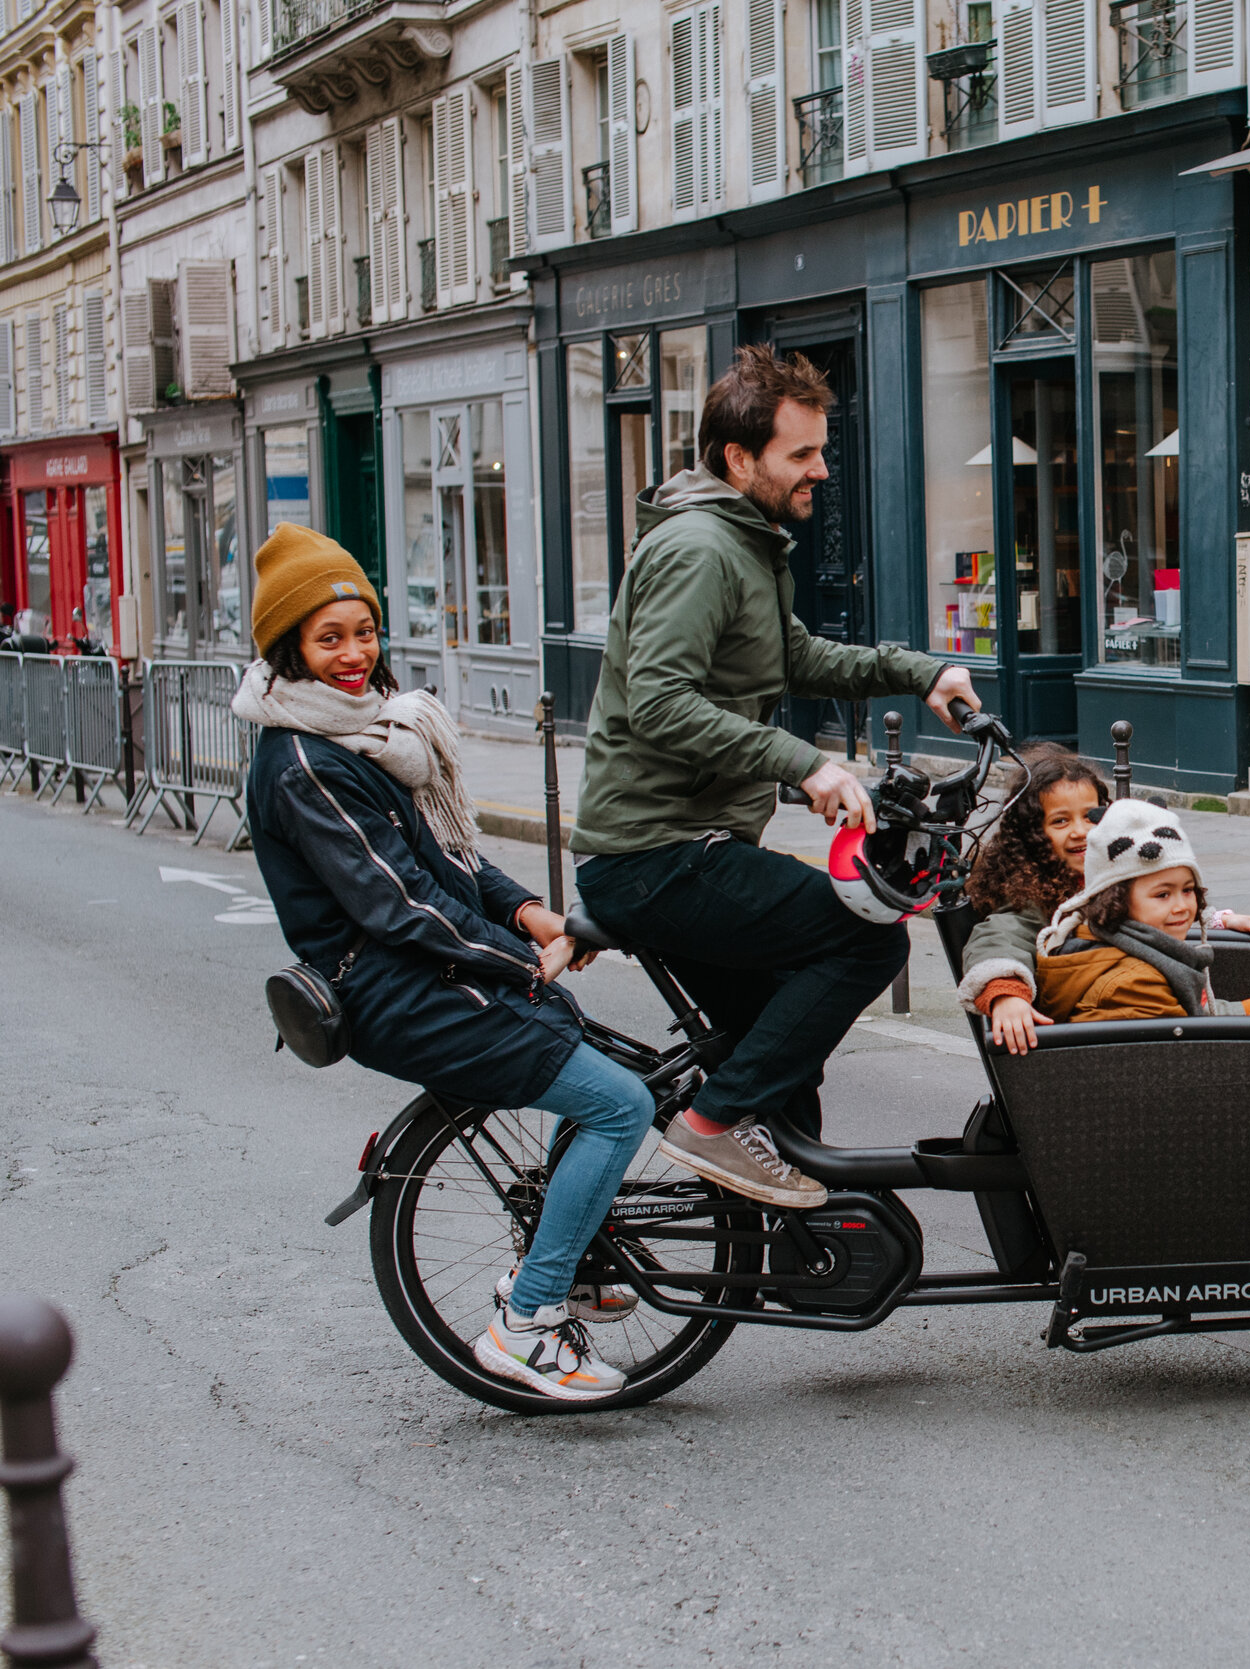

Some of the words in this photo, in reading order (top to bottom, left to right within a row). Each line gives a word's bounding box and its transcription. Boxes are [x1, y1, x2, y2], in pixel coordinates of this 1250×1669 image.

[959, 191, 1073, 246] PAPIER
[1081, 185, 1108, 224] +
[576, 282, 633, 318] GALERIE
[1105, 638, 1131, 650] PAPIER
[611, 1206, 651, 1217] URBAN
[652, 1203, 695, 1214] ARROW
[1090, 1286, 1181, 1305] URBAN
